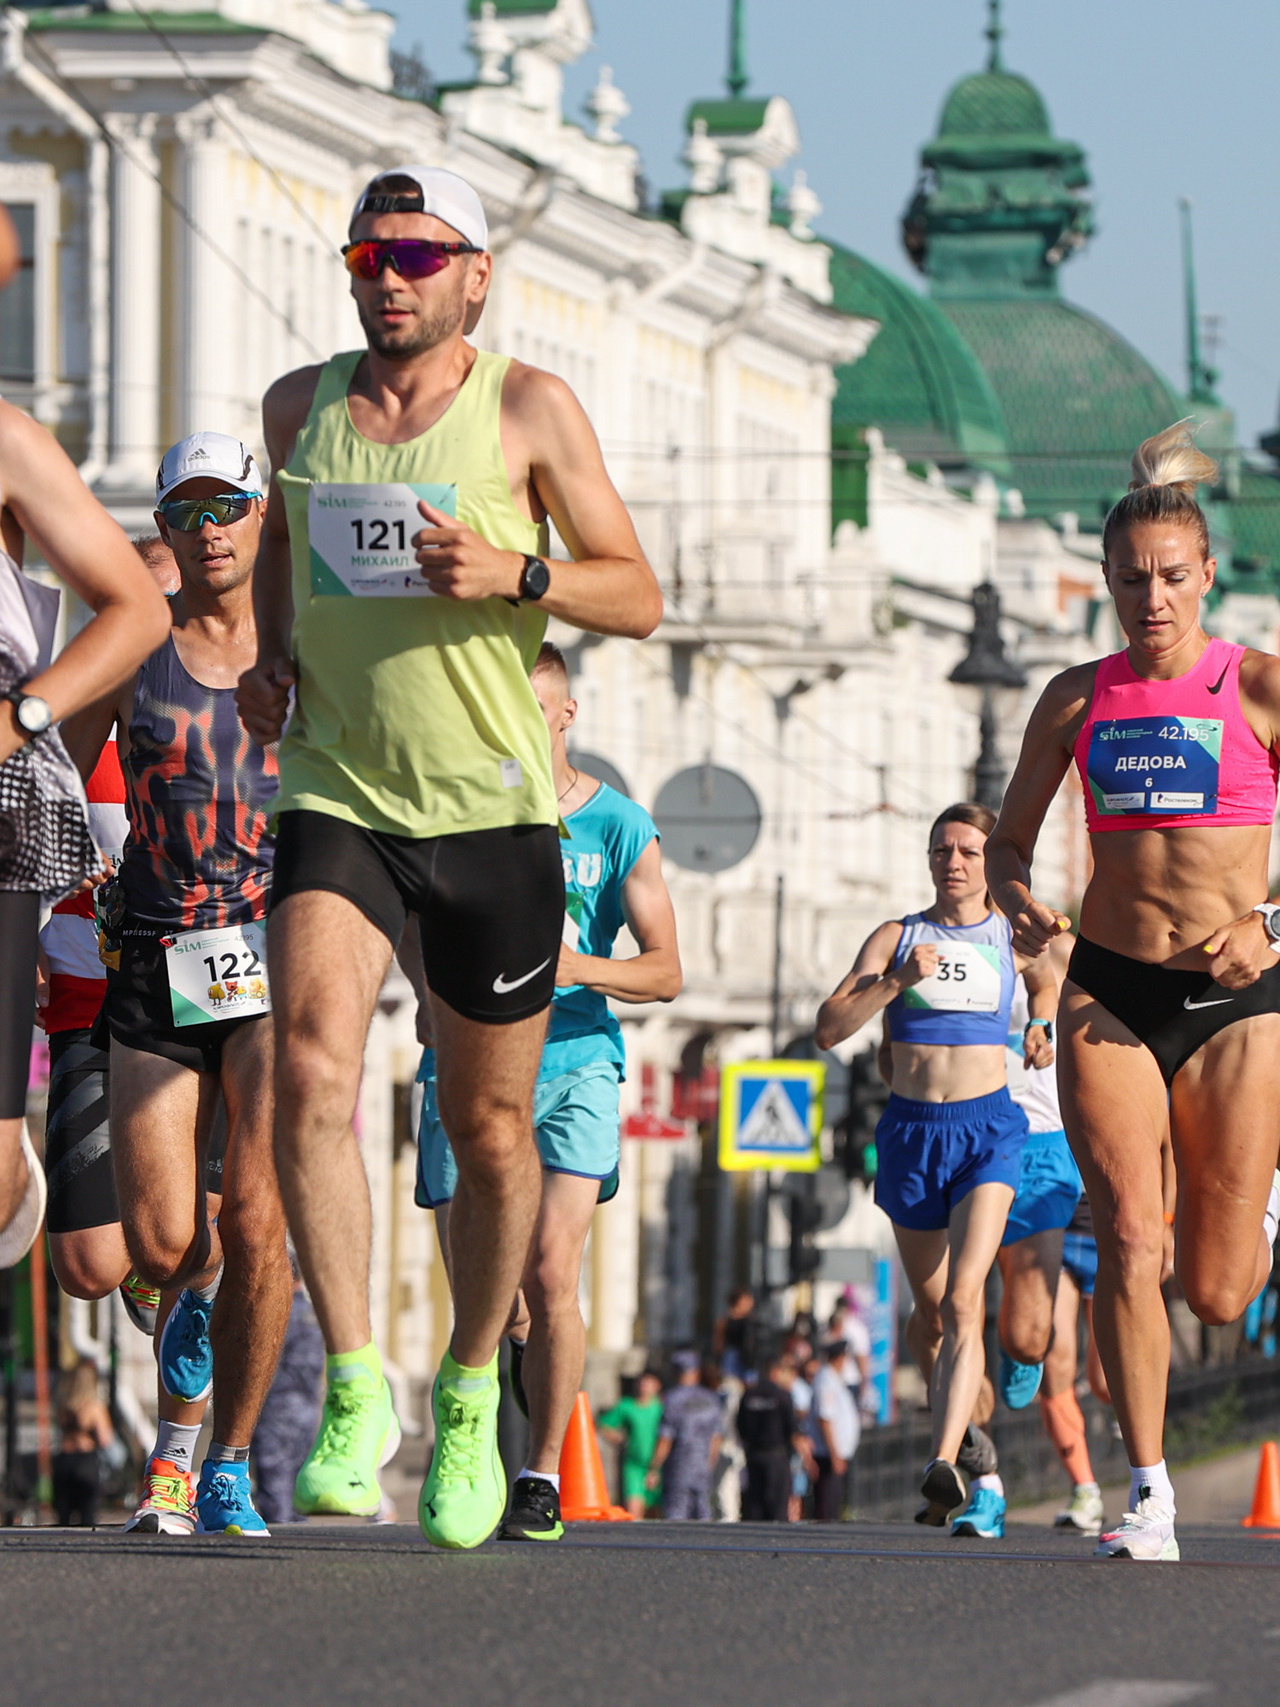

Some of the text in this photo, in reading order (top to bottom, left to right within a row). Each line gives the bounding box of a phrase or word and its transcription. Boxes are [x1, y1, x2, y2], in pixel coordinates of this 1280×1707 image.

[351, 518, 405, 550] 121
[351, 555, 409, 566] МИХАИЛ
[1158, 726, 1210, 742] 42.195
[1115, 755, 1187, 772] ДЕДОВА
[1145, 777, 1153, 787] 6
[203, 950, 262, 982] 122
[937, 963, 967, 981] 35
